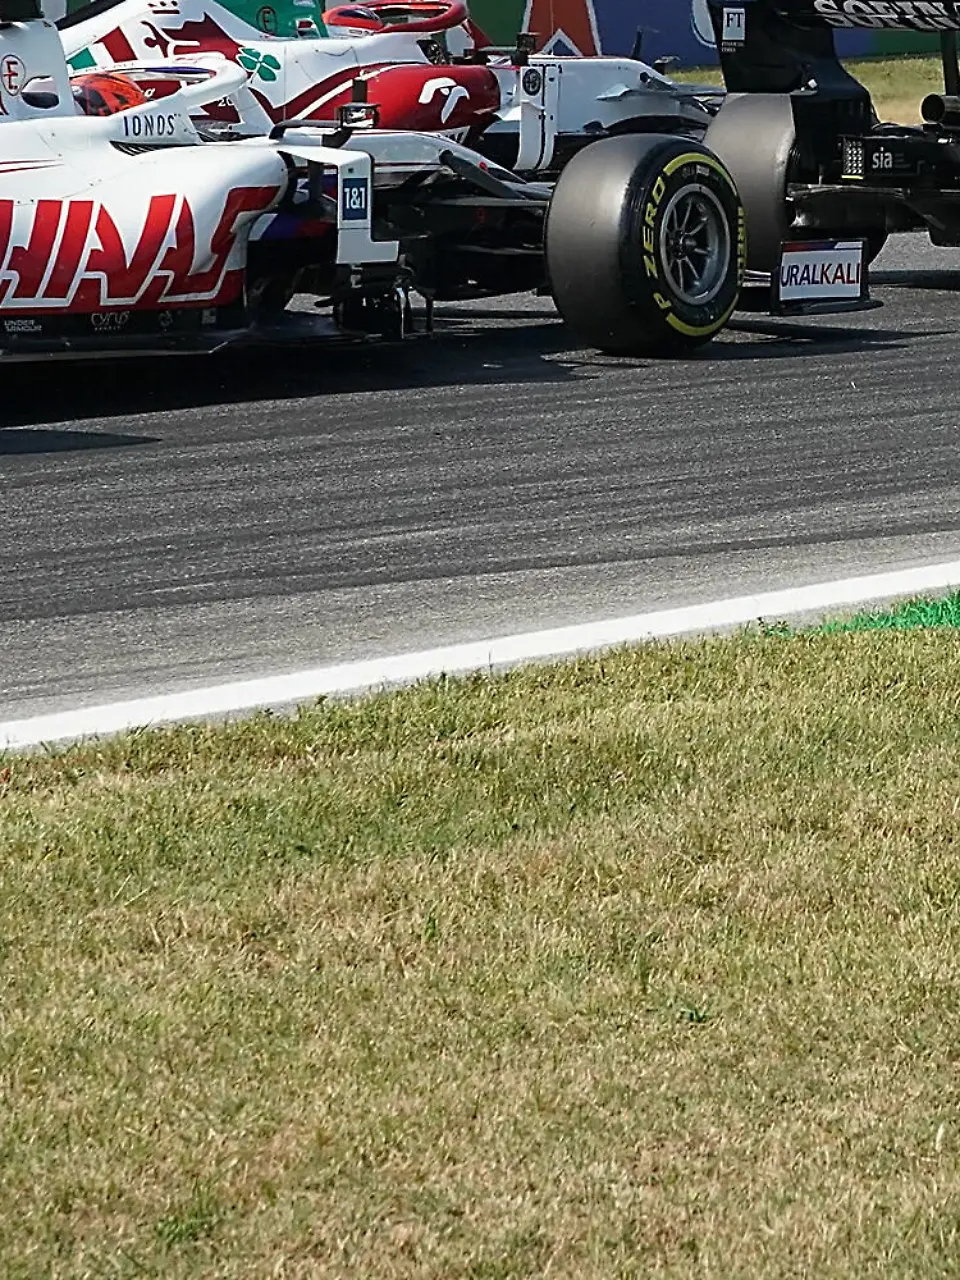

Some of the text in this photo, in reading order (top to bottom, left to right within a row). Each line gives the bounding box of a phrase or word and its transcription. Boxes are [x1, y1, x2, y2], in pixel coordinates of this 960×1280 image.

[726, 13, 744, 27] FT
[123, 114, 175, 137] IONOS
[872, 146, 893, 168] sia
[344, 187, 366, 209] 1&1
[642, 176, 666, 279] ZERO
[780, 263, 861, 286] URALKALI
